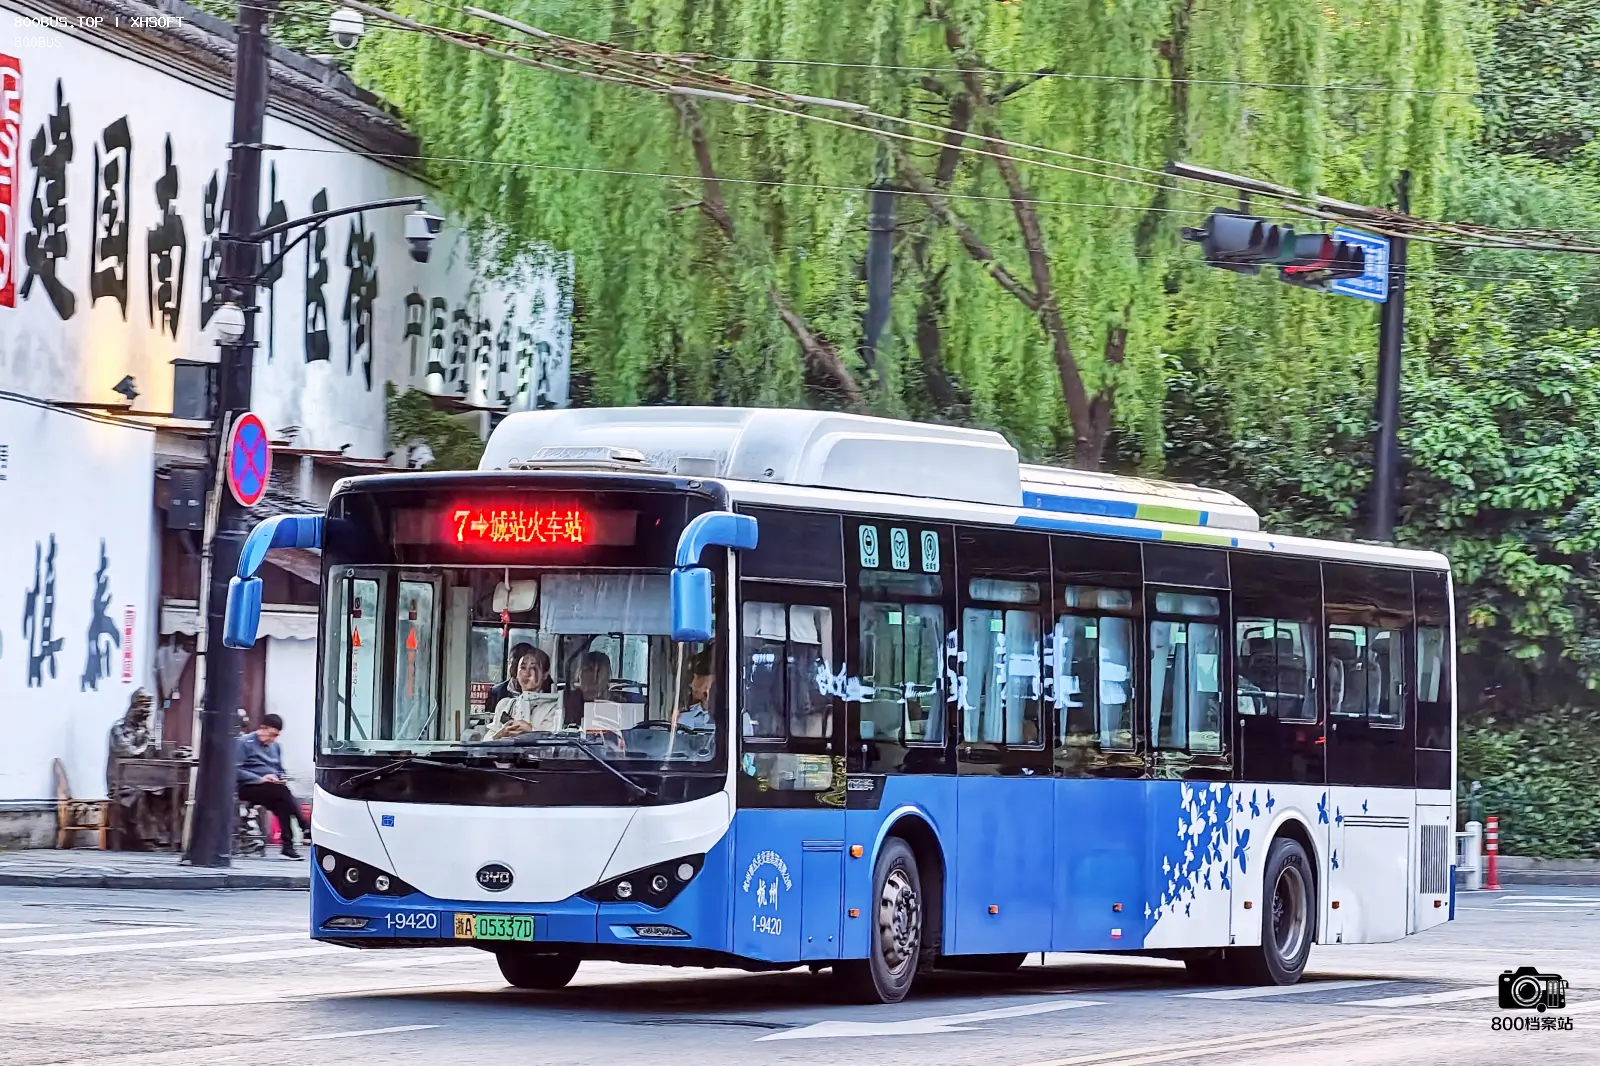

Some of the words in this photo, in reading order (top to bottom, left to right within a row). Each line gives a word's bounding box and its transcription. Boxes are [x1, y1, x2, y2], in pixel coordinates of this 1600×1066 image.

[453, 510, 471, 542] 7
[489, 509, 583, 543] 城站火车站
[479, 870, 510, 883] BYD
[756, 876, 779, 911] 杭州
[384, 913, 437, 930] 1-9420
[751, 914, 782, 936] 1-9420
